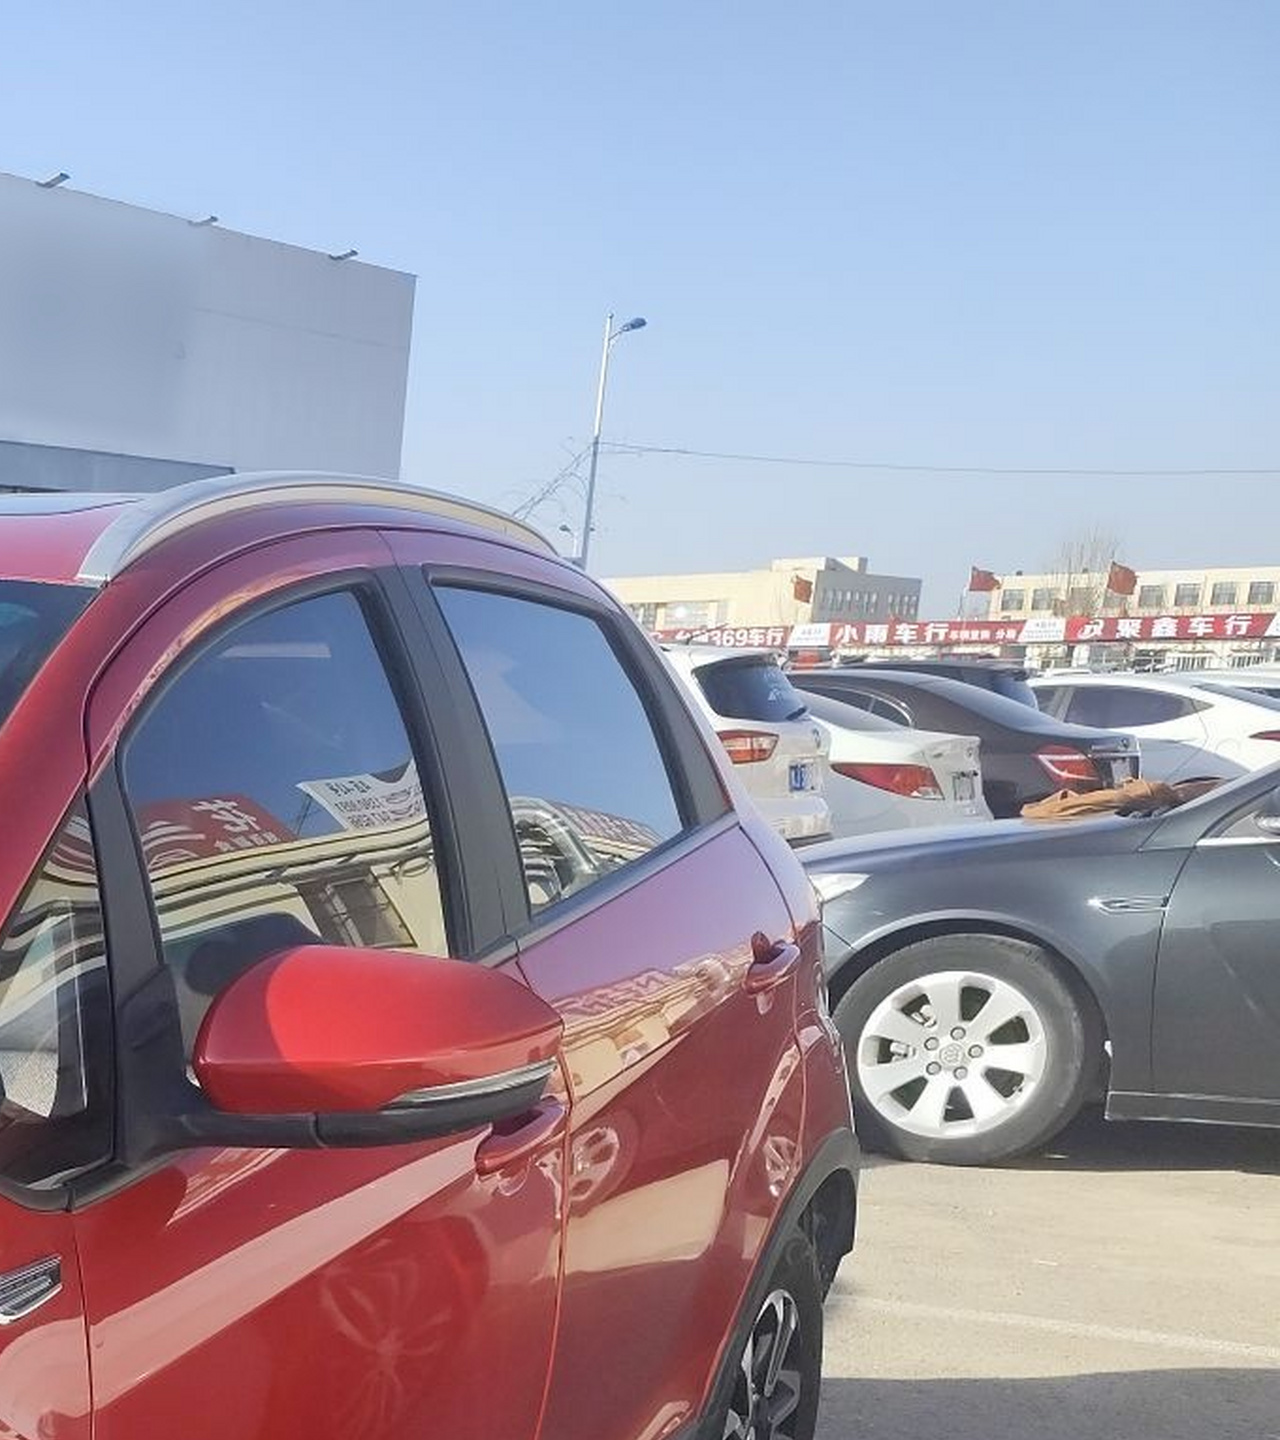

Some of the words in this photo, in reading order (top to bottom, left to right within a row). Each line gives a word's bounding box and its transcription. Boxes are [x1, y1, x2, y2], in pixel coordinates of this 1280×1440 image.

[835, 622, 949, 645] 小雨车行
[1116, 614, 1252, 639] 聚鑫车行
